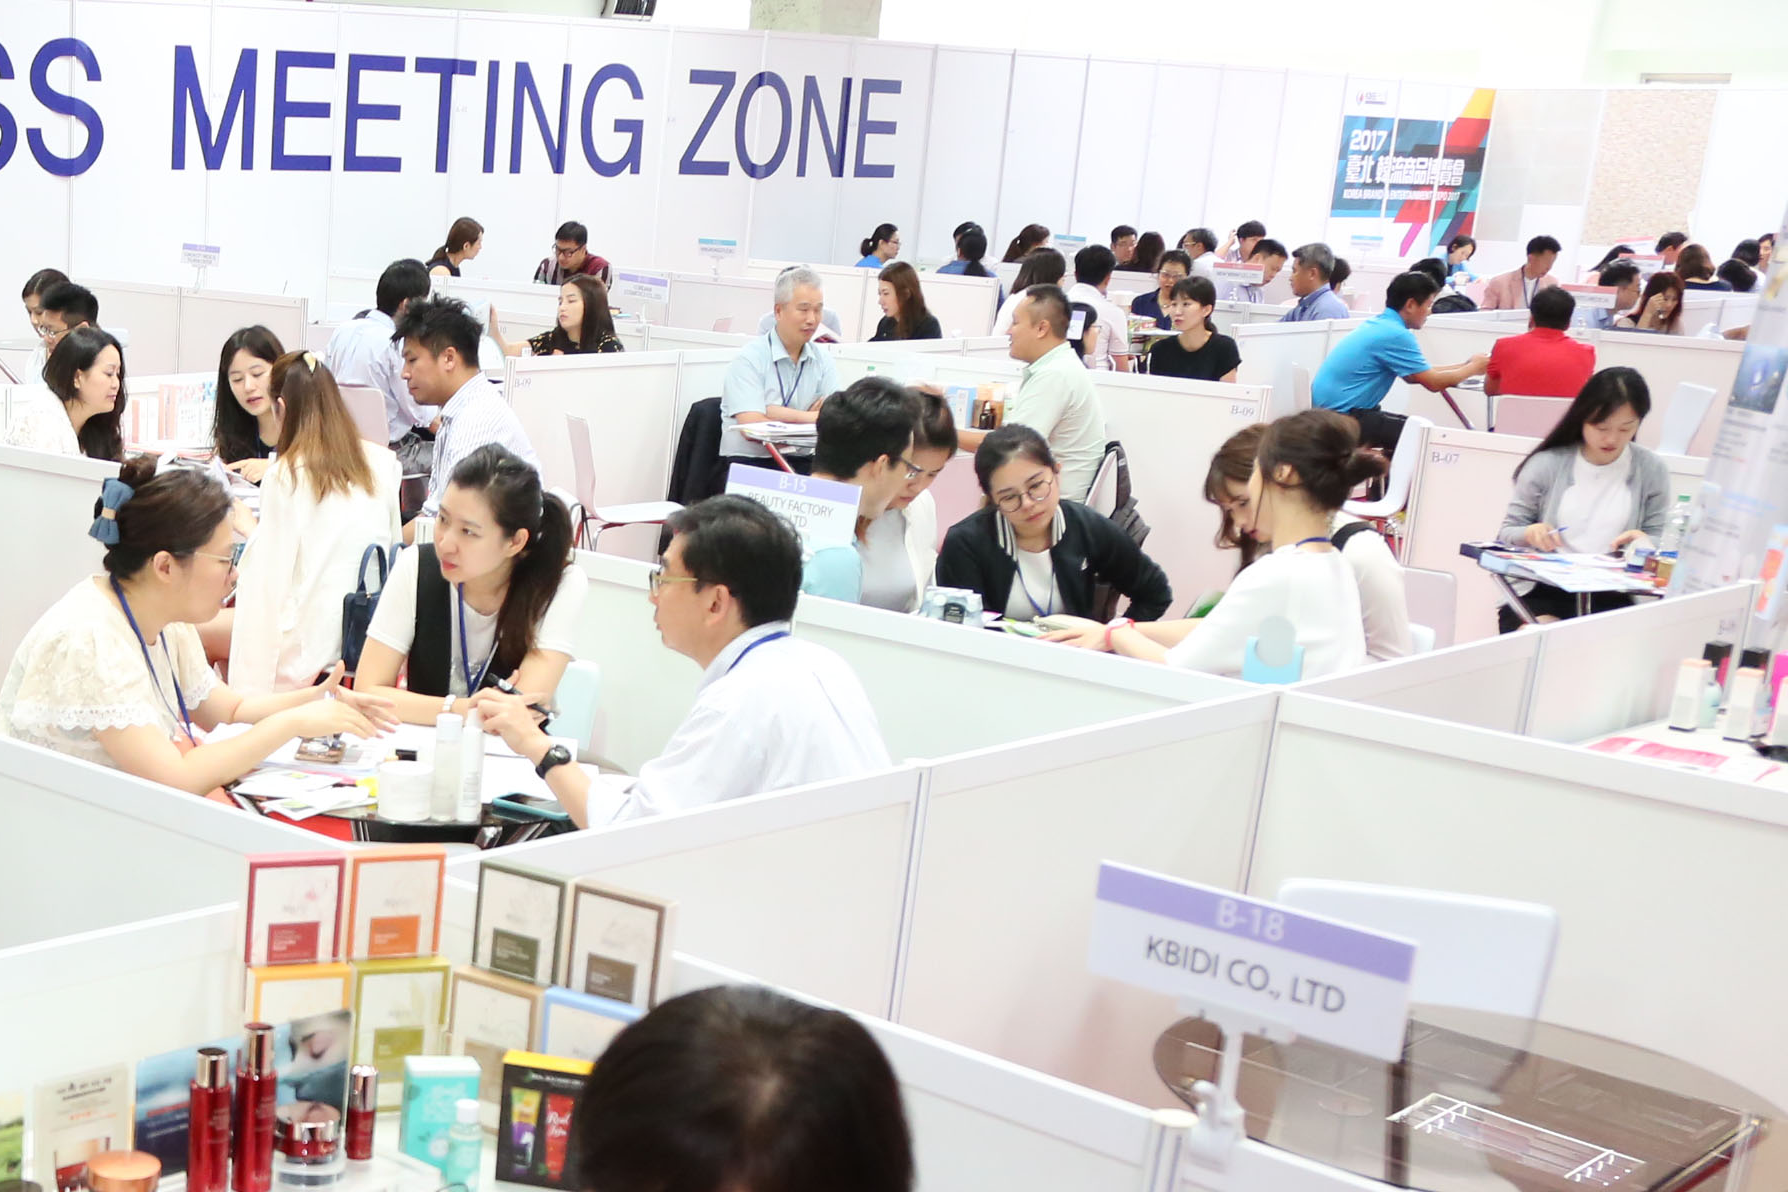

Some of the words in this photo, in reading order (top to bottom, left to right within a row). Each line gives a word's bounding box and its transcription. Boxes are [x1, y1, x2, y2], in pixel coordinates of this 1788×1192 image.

[172, 44, 644, 177] MEETING
[679, 70, 903, 179] ZONE
[1349, 129, 1389, 152] 2017
[1344, 154, 1375, 184] 臺北
[1343, 188, 1363, 199] KOREA
[1230, 405, 1254, 417] B-09
[1431, 451, 1460, 465] B-07
[779, 475, 808, 493] B-15
[748, 491, 786, 511] BEAUTY
[787, 500, 835, 518] FACTORY
[789, 514, 808, 528] LTD
[1215, 897, 1286, 942] B-18
[1144, 935, 1221, 979] KBIDI
[1227, 958, 1282, 1001] CO.,
[1291, 975, 1346, 1014] LTD
